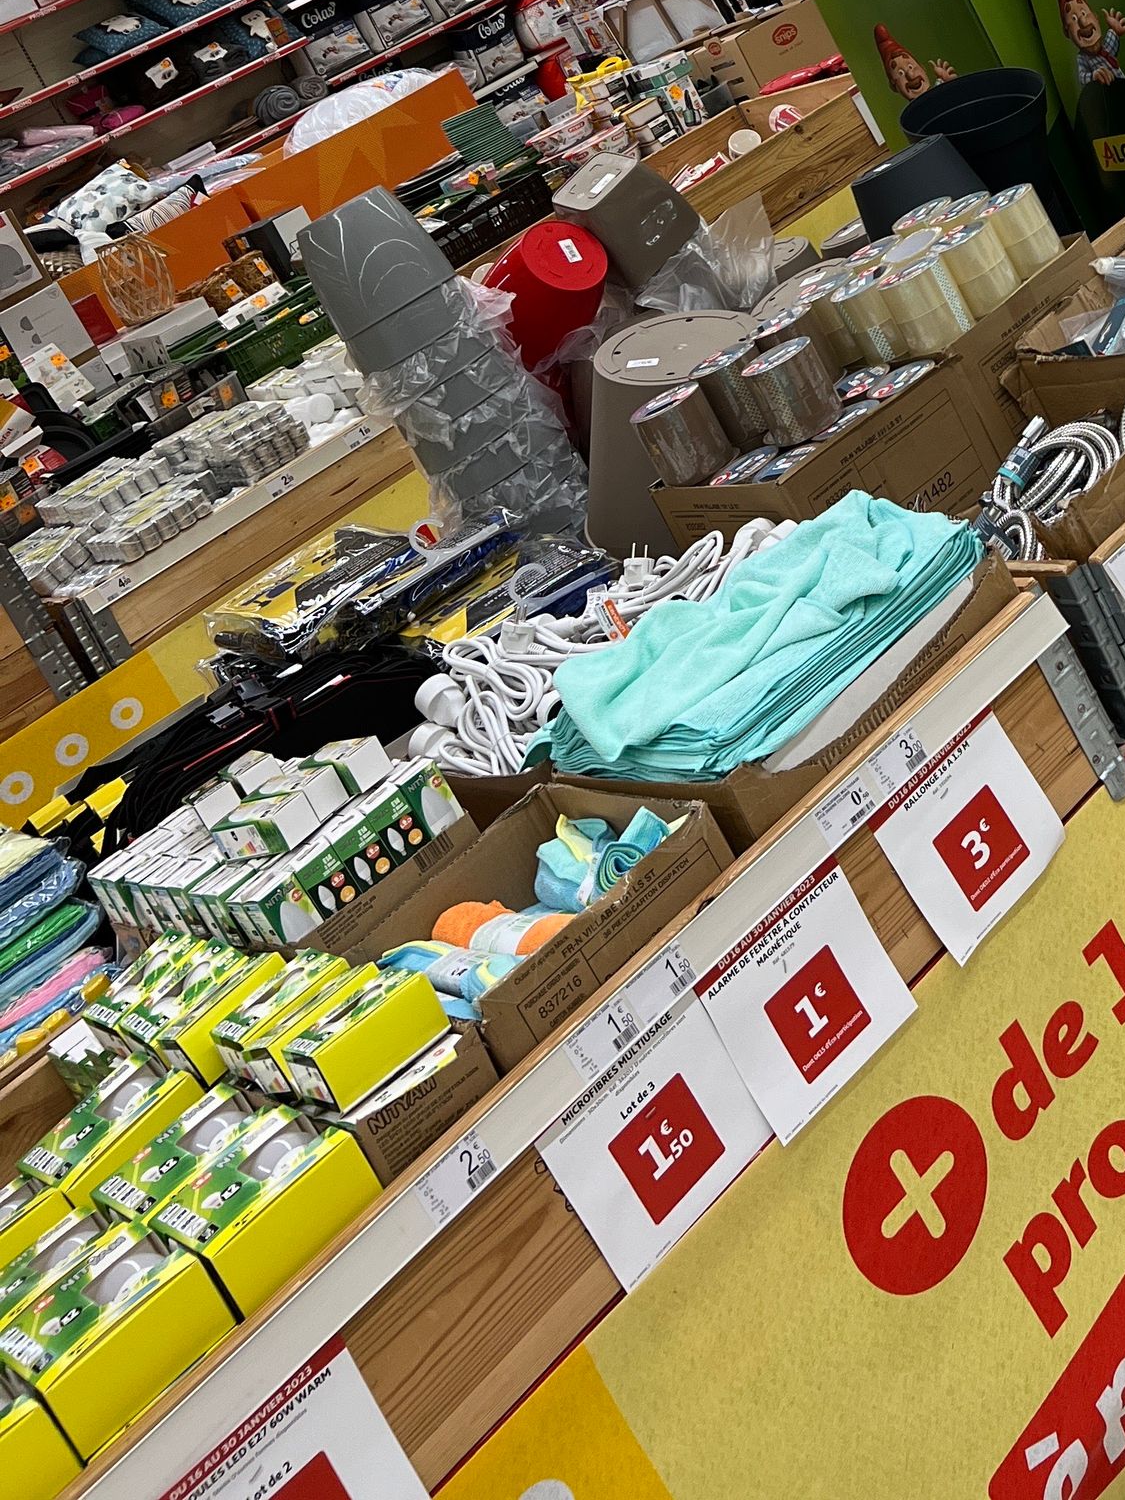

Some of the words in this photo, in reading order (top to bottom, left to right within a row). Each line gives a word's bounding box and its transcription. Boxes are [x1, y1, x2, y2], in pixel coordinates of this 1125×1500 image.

[301, 2, 336, 28] Colas
[904, 775, 939, 811] RALLONGE
[939, 765, 947, 776] 16
[947, 759, 953, 767] A
[952, 749, 962, 760] 1.9
[962, 741, 970, 750] M
[961, 817, 990, 870] 3€
[561, 934, 583, 959] FR-N
[583, 904, 622, 936] VILLABE
[633, 880, 644, 893] LS
[644, 868, 656, 884] ST
[708, 966, 739, 1000] ALARME
[739, 956, 750, 968] DE
[750, 924, 782, 958] FENÊTRE
[782, 917, 790, 930] À
[789, 871, 839, 920] CONTACTEUR
[718, 958, 730, 970] DU
[731, 947, 741, 958] 16
[741, 935, 752, 948] AU
[752, 925, 763, 937] 30
[764, 895, 796, 926] JANVIER
[796, 875, 815, 897] 2023
[756, 922, 801, 967] MAGNÉTIQUE
[538, 975, 583, 1020] 837216
[794, 981, 829, 1039] 1€
[562, 1066, 618, 1125] MICROFIBRES
[618, 1011, 672, 1069] MULTIUSAGE
[615, 1071, 639, 1096] disponibles
[620, 1101, 637, 1120] Lot
[637, 1089, 649, 1103] de
[648, 1082, 656, 1091] 3
[991, 1001, 1100, 1141] de
[367, 1075, 437, 1135] NITYAM
[168, 1484, 187, 1500] DU
[188, 1469, 202, 1486] 16
[203, 1452, 220, 1472] AU
[222, 1437, 236, 1455] 30
[238, 1394, 284, 1441] JANVIER
[285, 1365, 312, 1396] 2023
[185, 1468, 225, 1500] OULES
[226, 1449, 247, 1472] LED
[248, 1428, 268, 1449] E27
[270, 1404, 296, 1428] 60W
[296, 1367, 331, 1404] WARM
[1025, 1431, 1088, 1500] à
